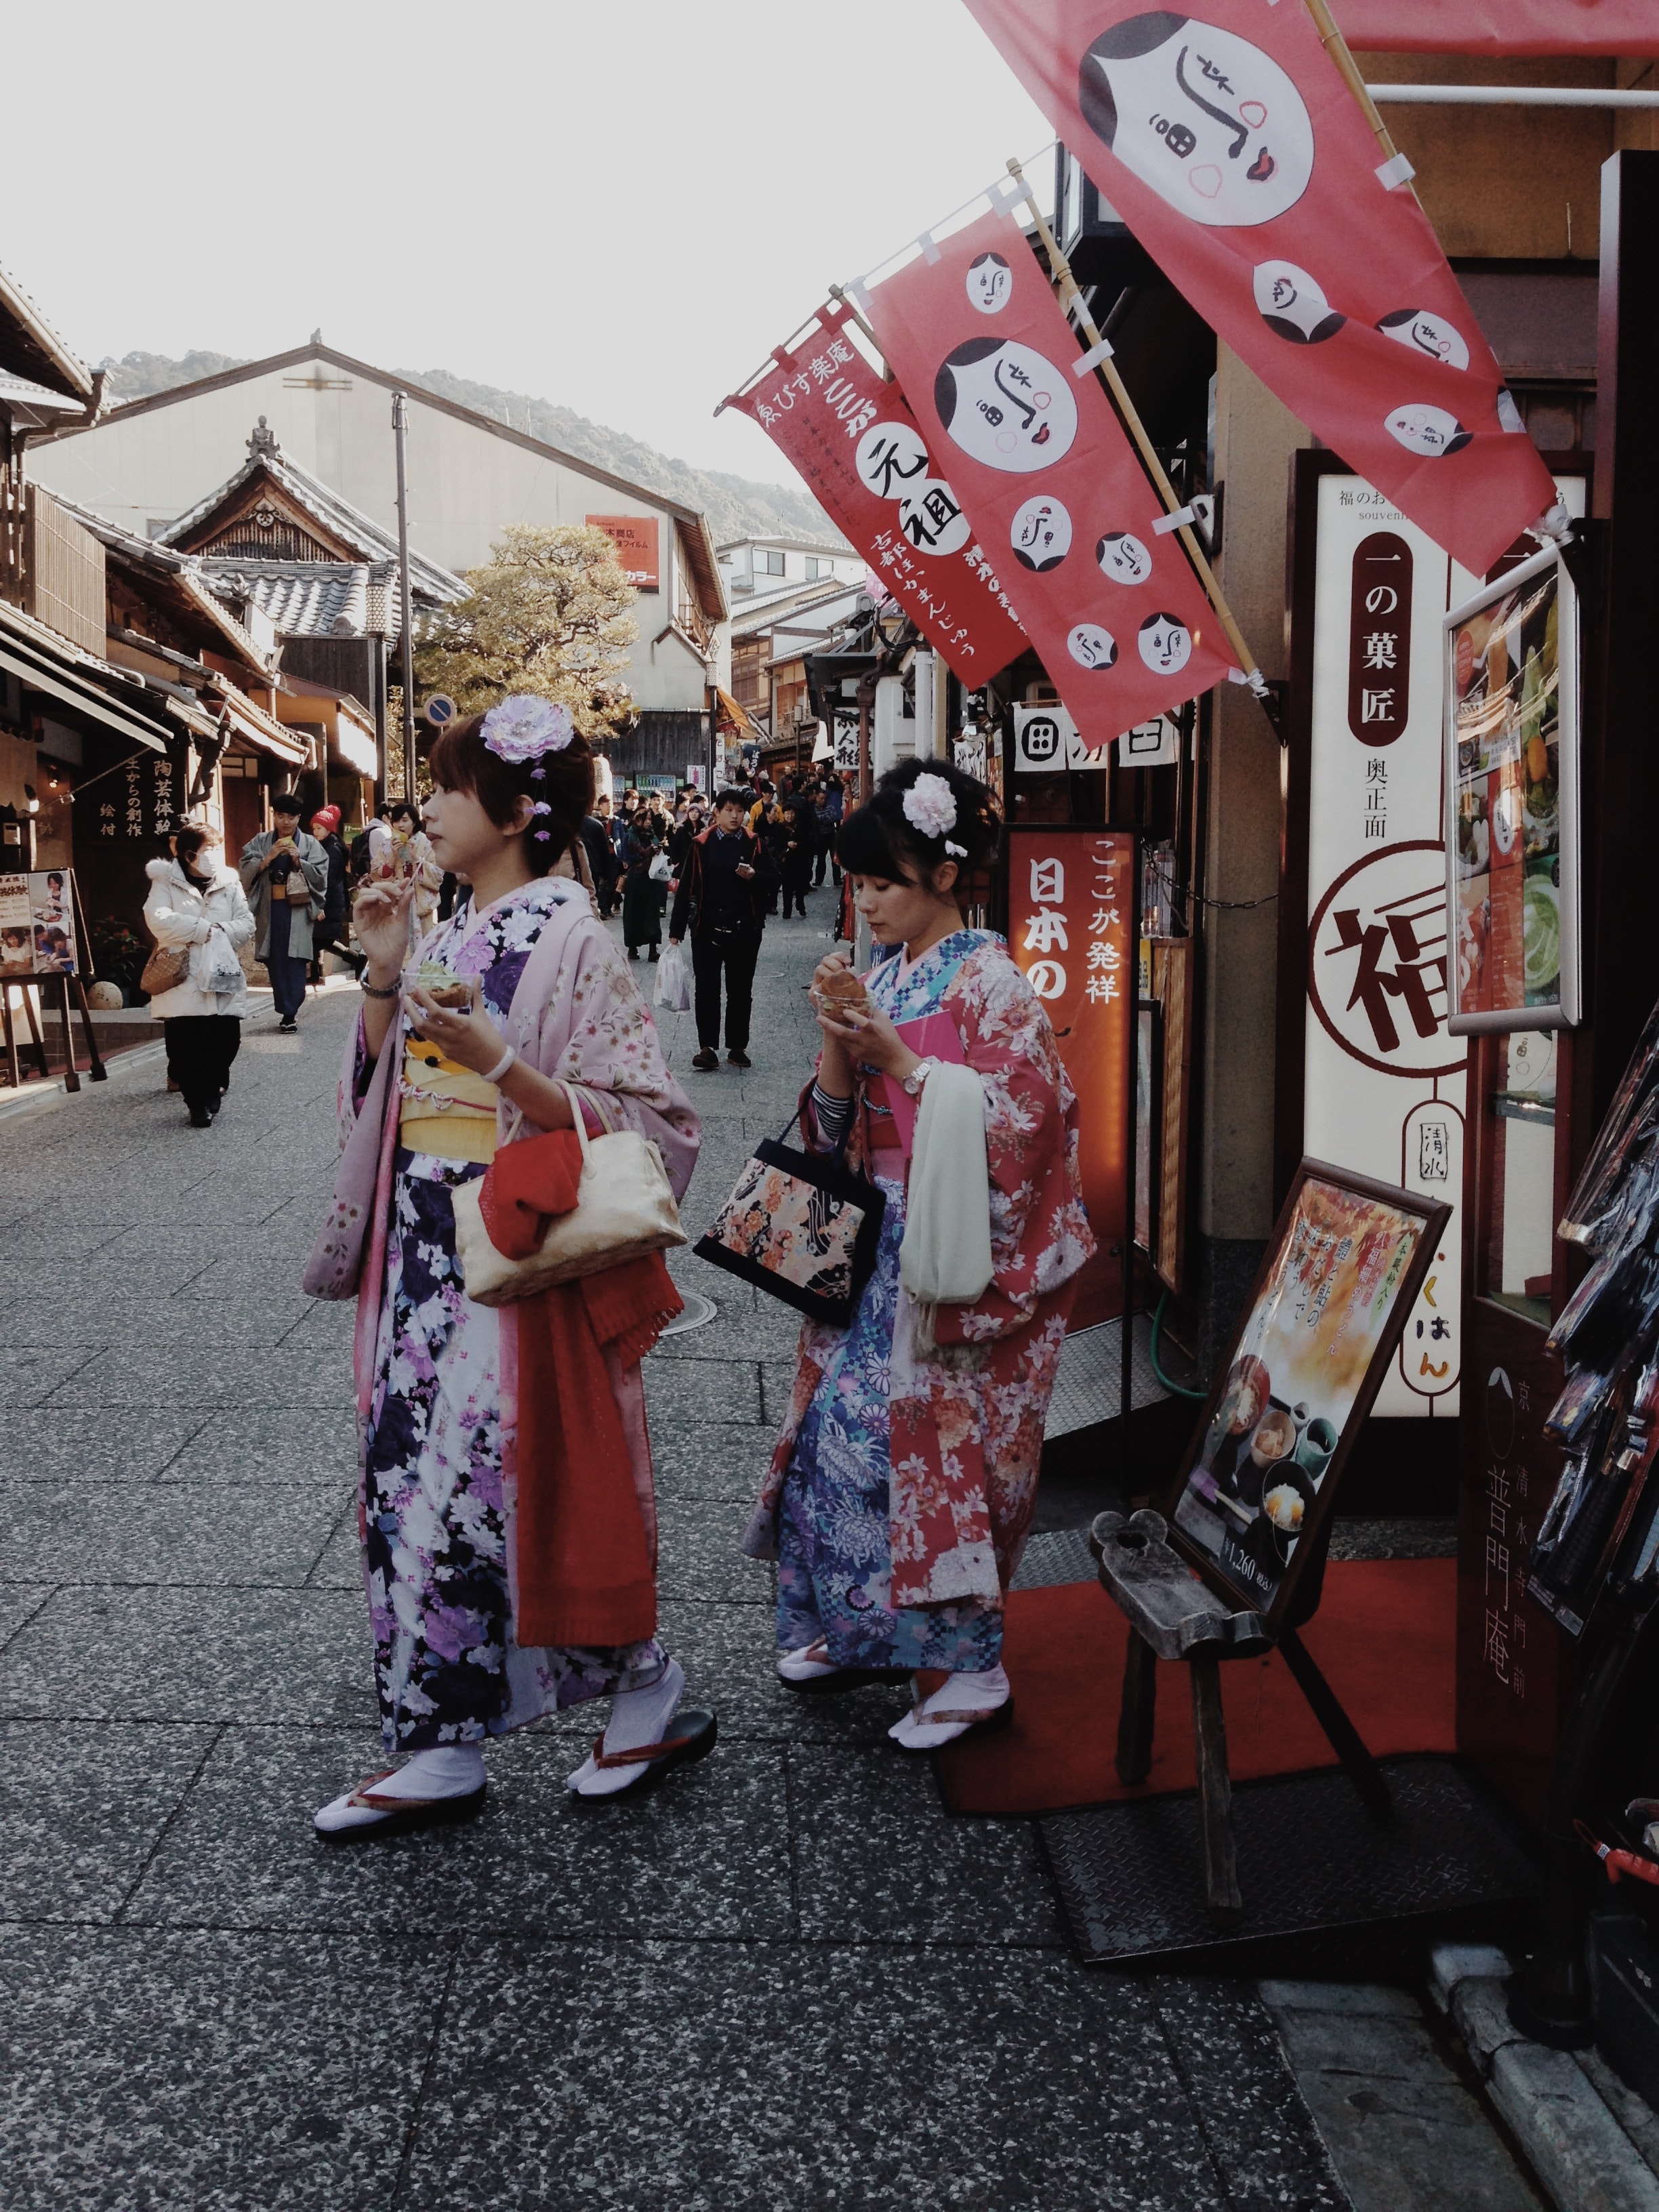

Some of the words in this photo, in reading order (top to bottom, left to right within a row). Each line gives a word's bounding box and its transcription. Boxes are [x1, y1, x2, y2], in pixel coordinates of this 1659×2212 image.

[823, 377, 877, 438] ここが
[867, 438, 962, 546] 元祖
[604, 529, 635, 538] 木商店
[1361, 554, 1401, 724] 一の菓匠
[100, 803, 116, 836] 絵付
[125, 757, 142, 837] 土からの創作
[154, 760, 174, 835] 陶芸体験
[1364, 758, 1389, 839] 奥正面
[1023, 857, 1069, 1000] 日本の
[1085, 840, 1120, 1004] ここが発祥
[1424, 1126, 1446, 1176] 清水
[1416, 1250, 1451, 1378] くはん
